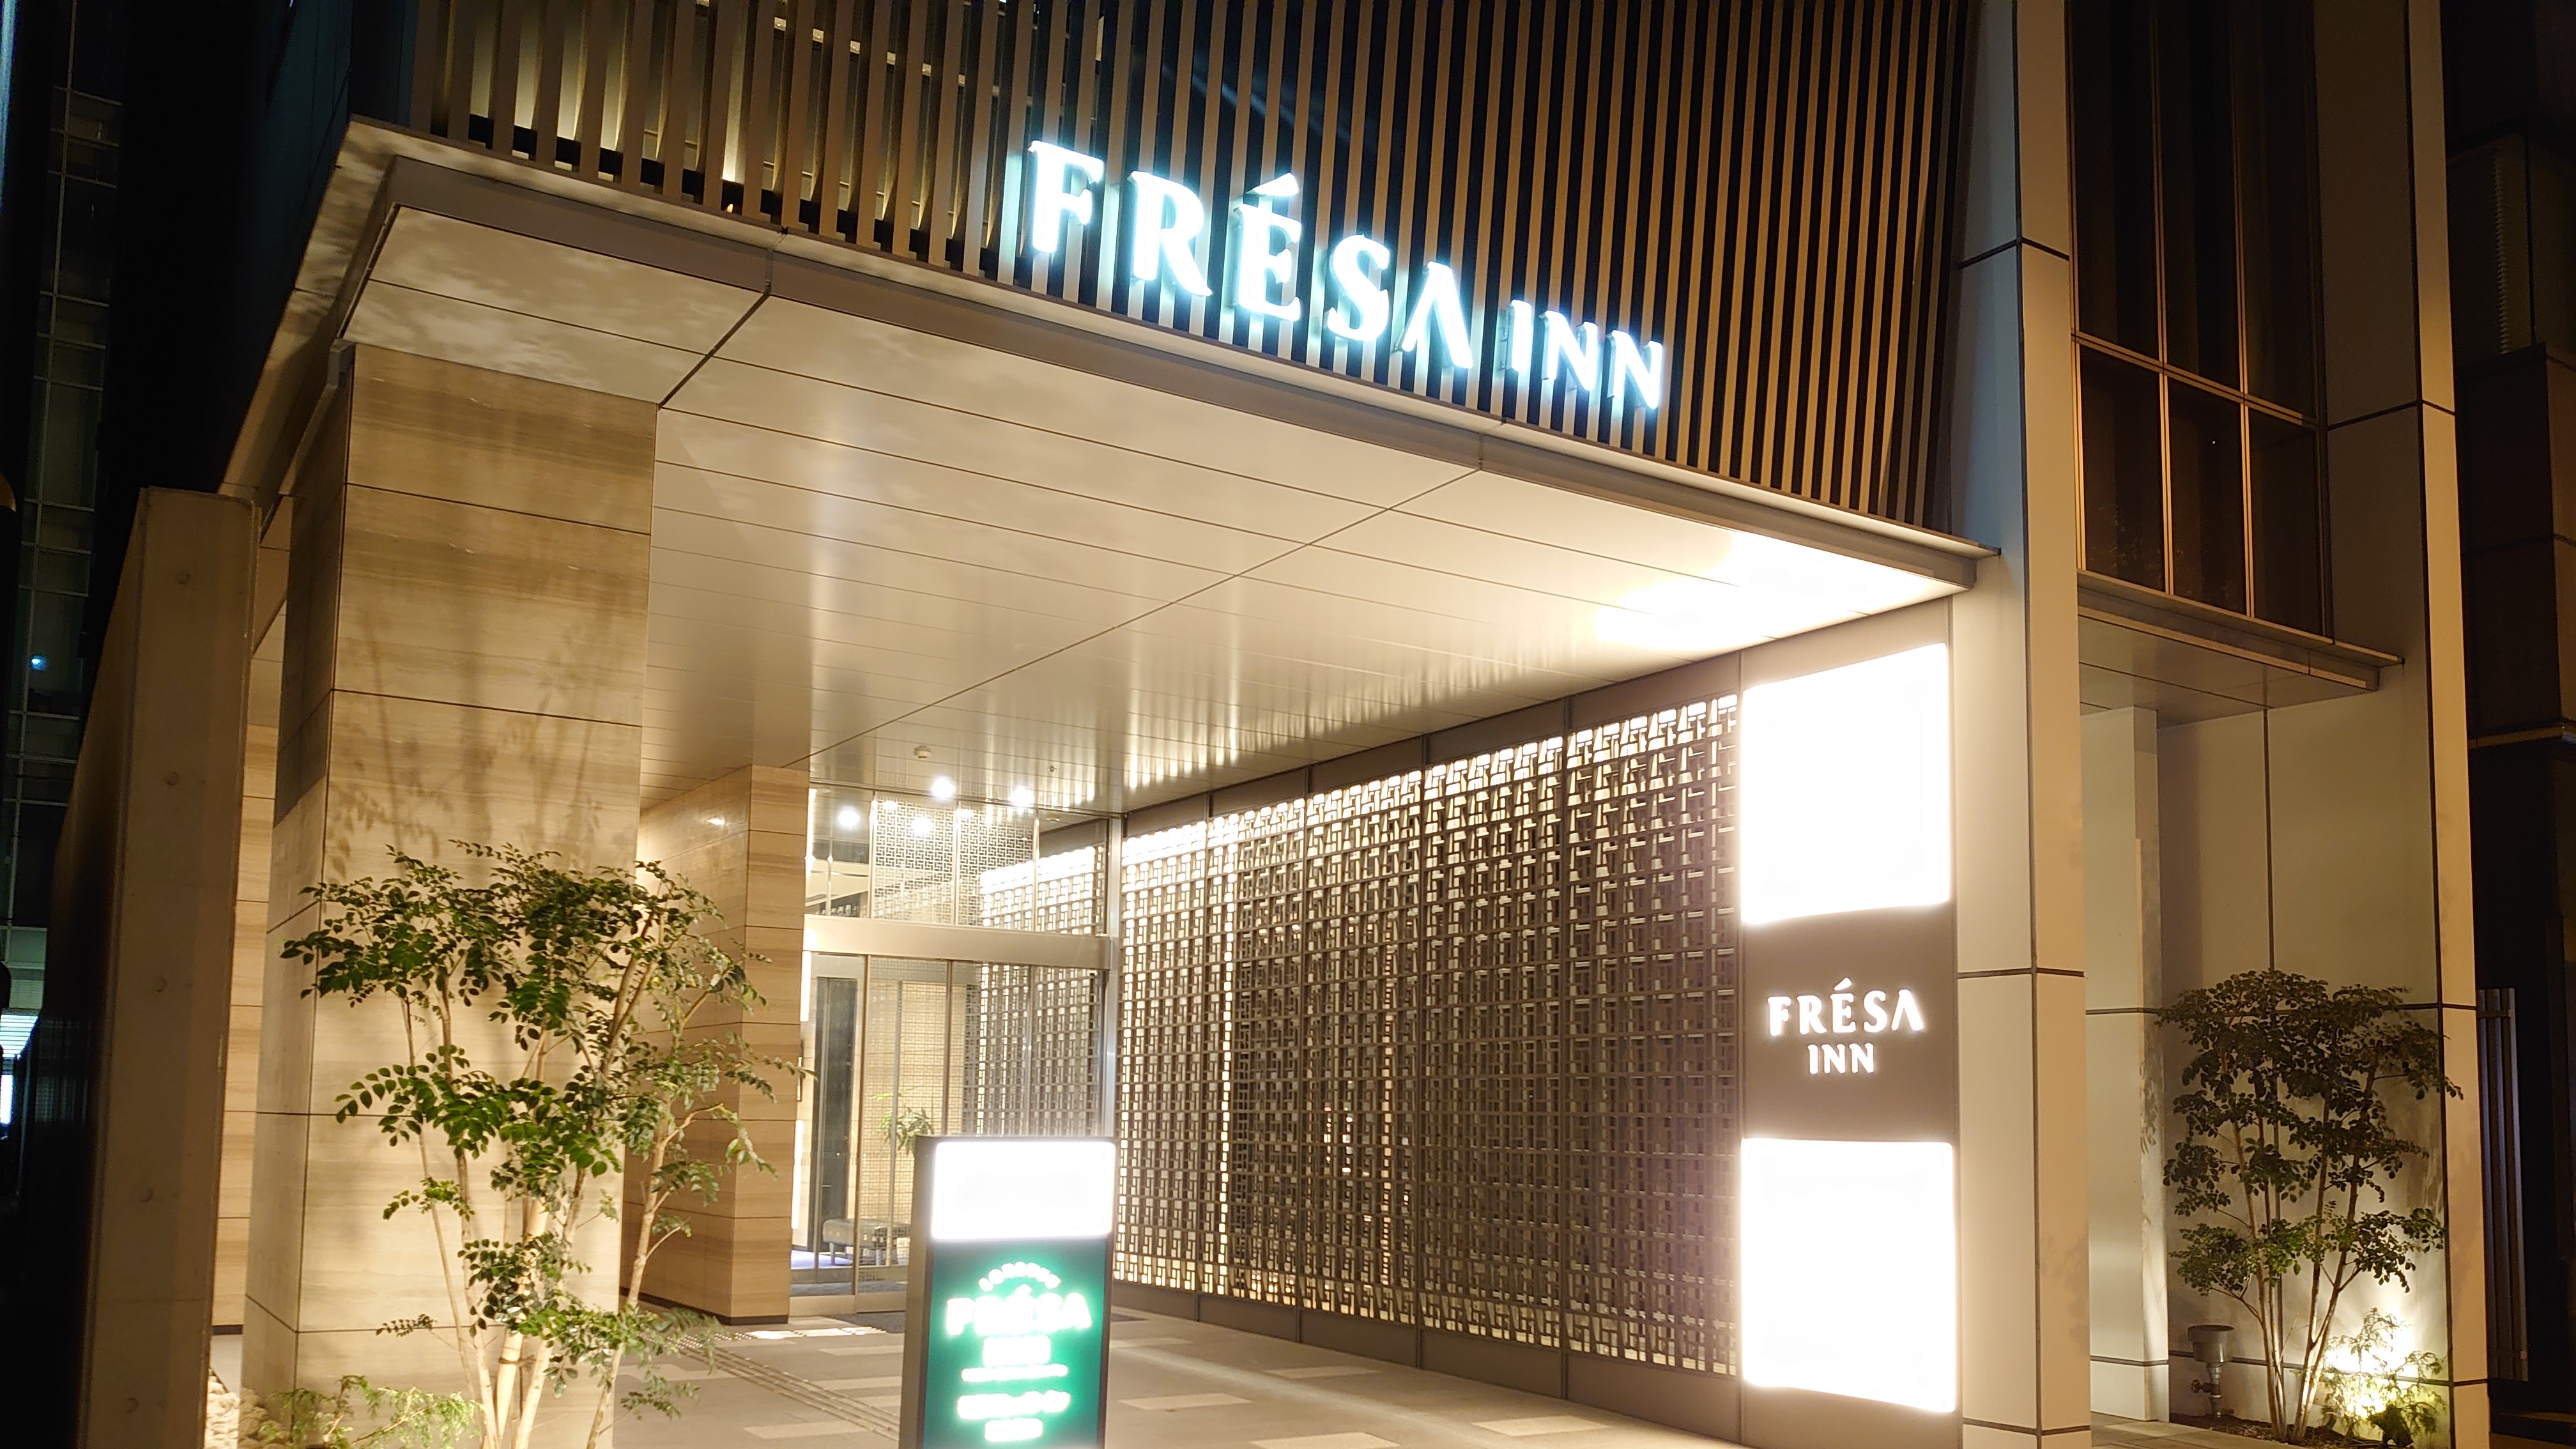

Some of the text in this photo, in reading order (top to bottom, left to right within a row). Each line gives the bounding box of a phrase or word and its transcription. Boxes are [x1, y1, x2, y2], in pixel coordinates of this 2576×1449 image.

[1027, 139, 1664, 410] FRÉSA INN
[1767, 977, 1924, 1036] FRÉSA
[1807, 1042, 1874, 1075] INN
